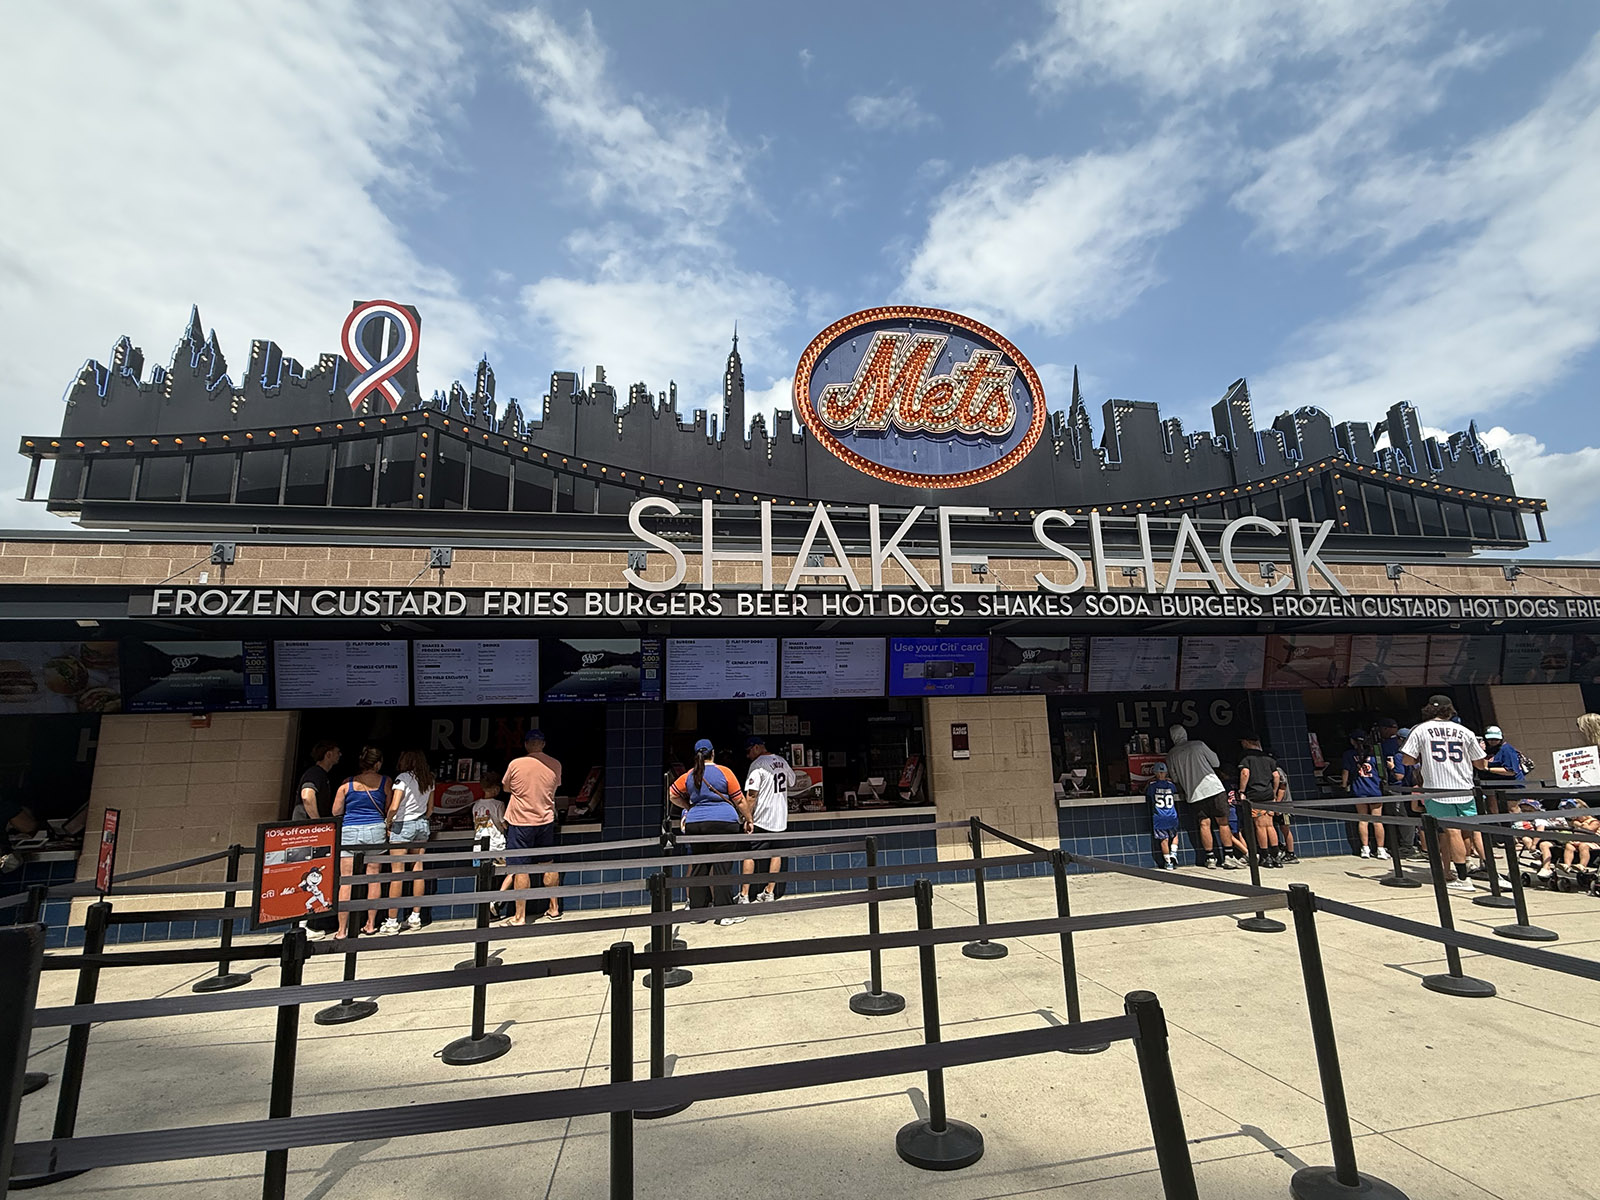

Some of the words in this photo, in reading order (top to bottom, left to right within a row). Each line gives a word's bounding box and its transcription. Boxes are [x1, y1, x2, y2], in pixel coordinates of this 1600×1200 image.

[817, 331, 1018, 436] Mets
[622, 496, 997, 592] SHAKE
[1032, 509, 1352, 597] SHACK
[151, 589, 300, 616] FROZEN
[311, 590, 467, 616] CUSTARD
[483, 591, 569, 616] FRIES
[585, 592, 723, 616] BURGERS
[737, 593, 808, 616] BEER
[822, 594, 883, 616] HOT
[888, 594, 964, 616] DOGS
[977, 594, 1073, 616] SHAKES
[1085, 595, 1150, 616] SODA
[1161, 595, 1263, 616] BURGERS
[1272, 596, 1357, 616] FROZEN
[1361, 597, 1451, 617] CUSTARD
[1459, 598, 1499, 618] HOT
[1505, 599, 1559, 618] DOGS
[894, 643, 914, 652] Use
[915, 644, 938, 653] your
[960, 642, 985, 652] card.
[1116, 699, 1200, 729] LET'S
[1427, 727, 1464, 740] POWERS
[1431, 740, 1463, 763] 55
[773, 772, 786, 794] 12
[1154, 794, 1175, 809] 50
[265, 829, 285, 838] 10%
[285, 827, 299, 836] off
[311, 825, 334, 834] deck.
[261, 889, 275, 899] citi
[280, 887, 296, 896] Mets
